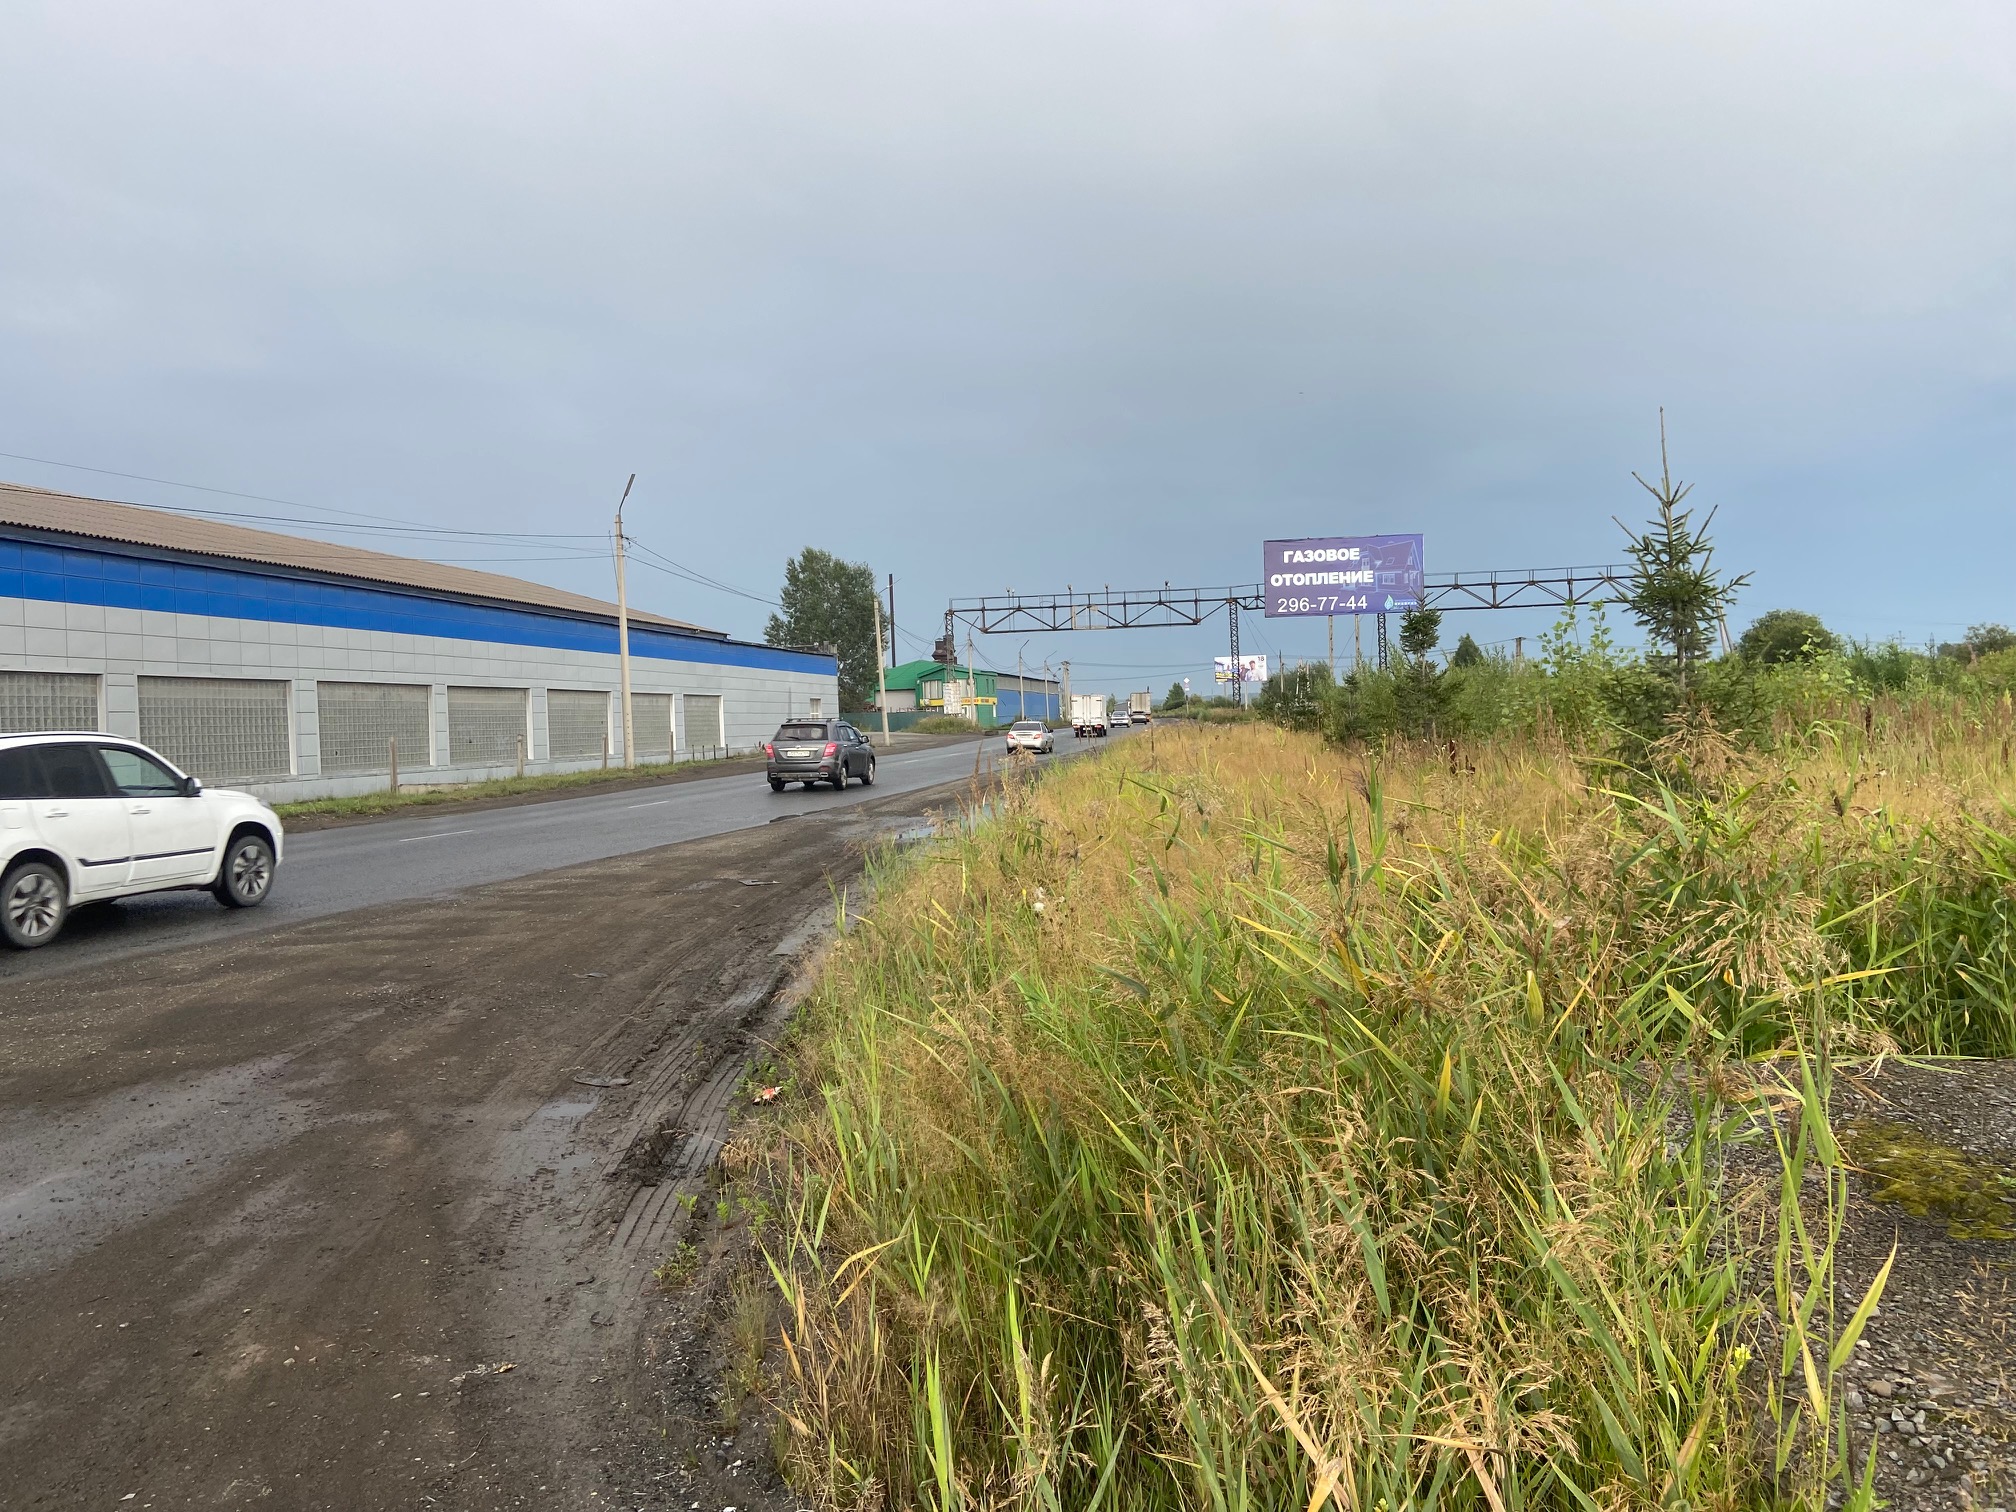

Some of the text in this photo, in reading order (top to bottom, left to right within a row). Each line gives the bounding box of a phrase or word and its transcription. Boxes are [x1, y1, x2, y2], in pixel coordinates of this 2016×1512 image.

[1283, 547, 1360, 563] ГАЗОВОЕ
[1270, 570, 1374, 587] ОТОПЛЕНИЕ
[1277, 595, 1367, 612] 296-77-44
